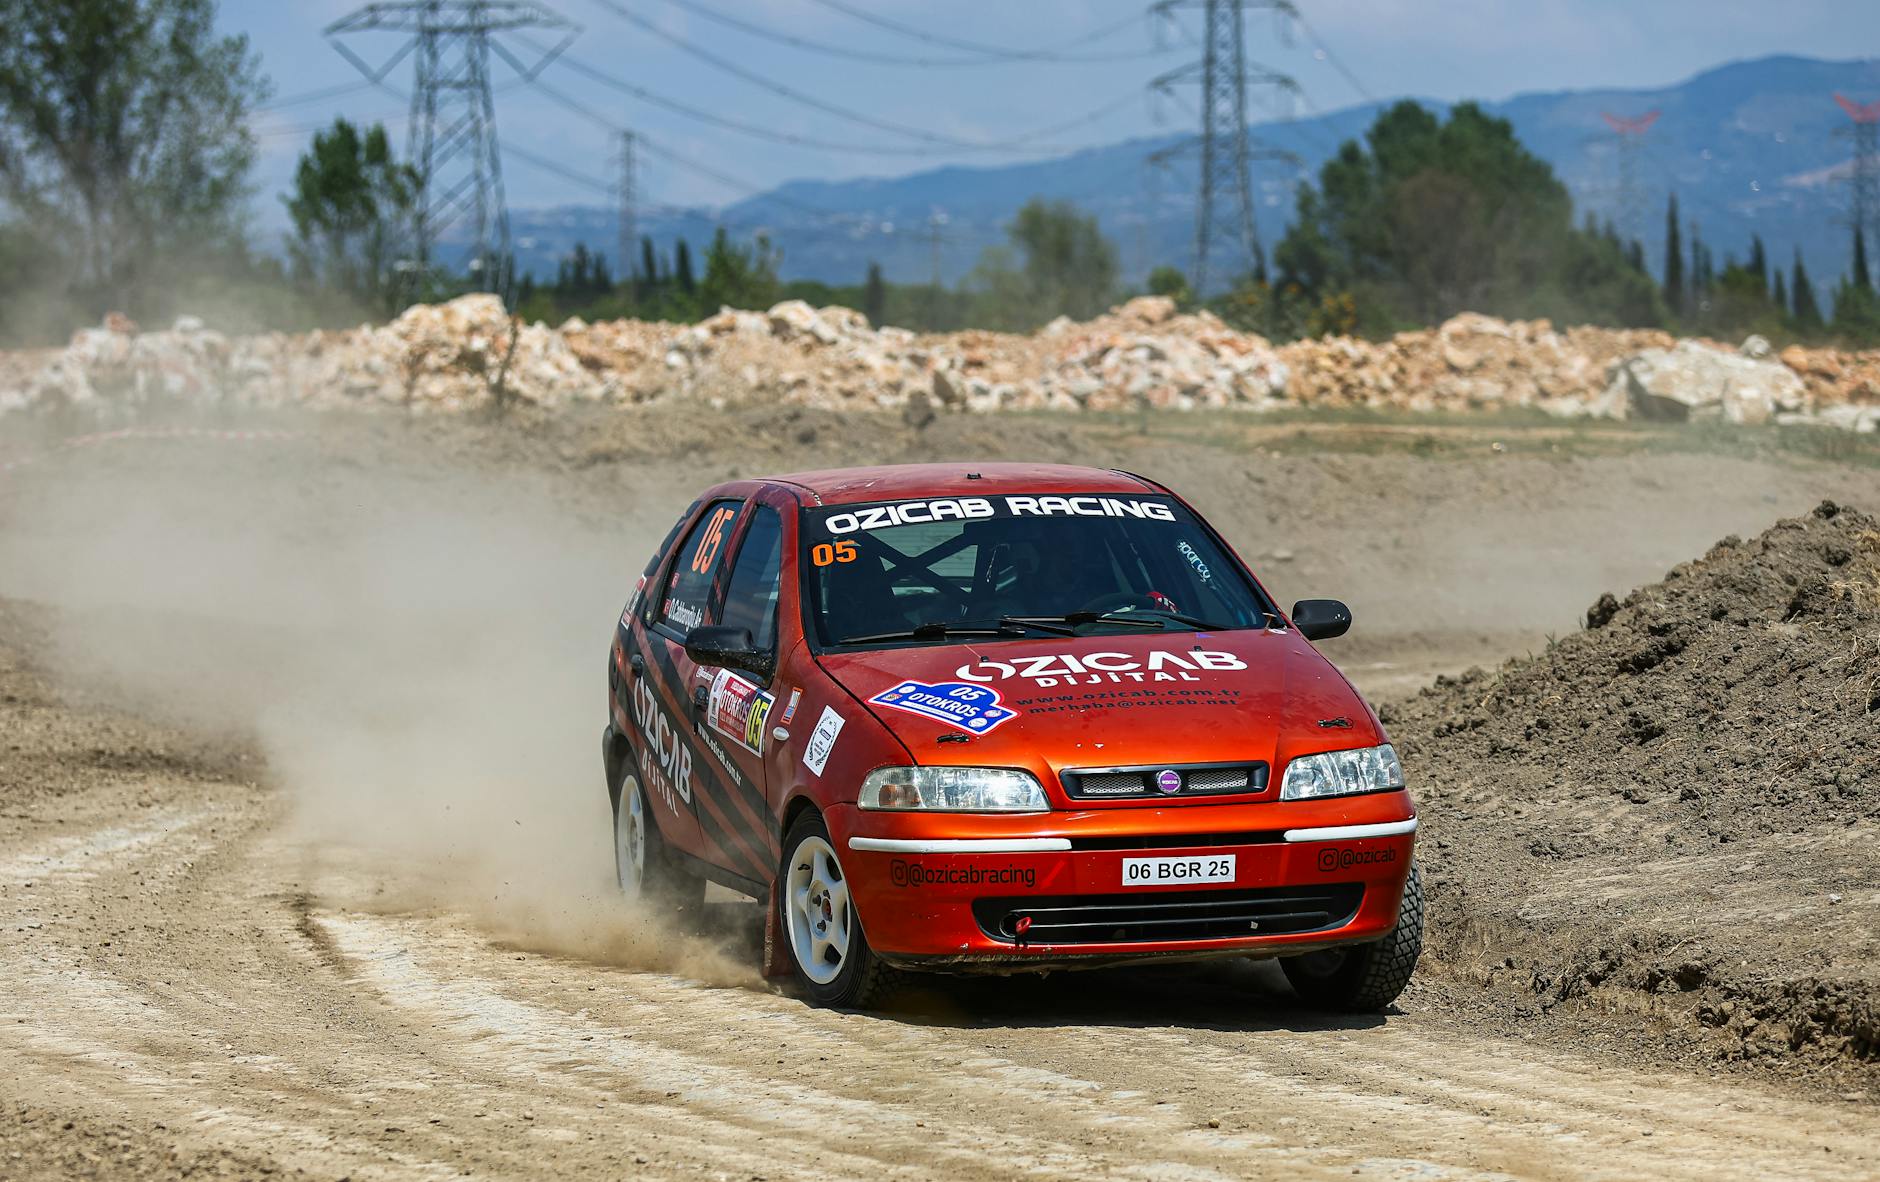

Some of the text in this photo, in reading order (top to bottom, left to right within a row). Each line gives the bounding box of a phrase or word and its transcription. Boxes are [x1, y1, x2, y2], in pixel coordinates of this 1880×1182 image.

[825, 497, 1177, 534] OZICAB RACING
[690, 507, 735, 574] 05
[812, 540, 857, 566] 05
[955, 650, 1248, 682] OZICAB
[908, 693, 980, 717] OTOKROS
[949, 687, 987, 700] 05
[1016, 688, 1241, 706] www.ozicab.com.tr
[1029, 698, 1239, 715] merhaba@ozicab.net
[747, 698, 769, 747] 05
[634, 676, 692, 804] OZICAB
[1128, 860, 1231, 880] 06 BGR 25
[1340, 848, 1397, 869] @ozicab
[908, 860, 1036, 887] @ozicabracing
